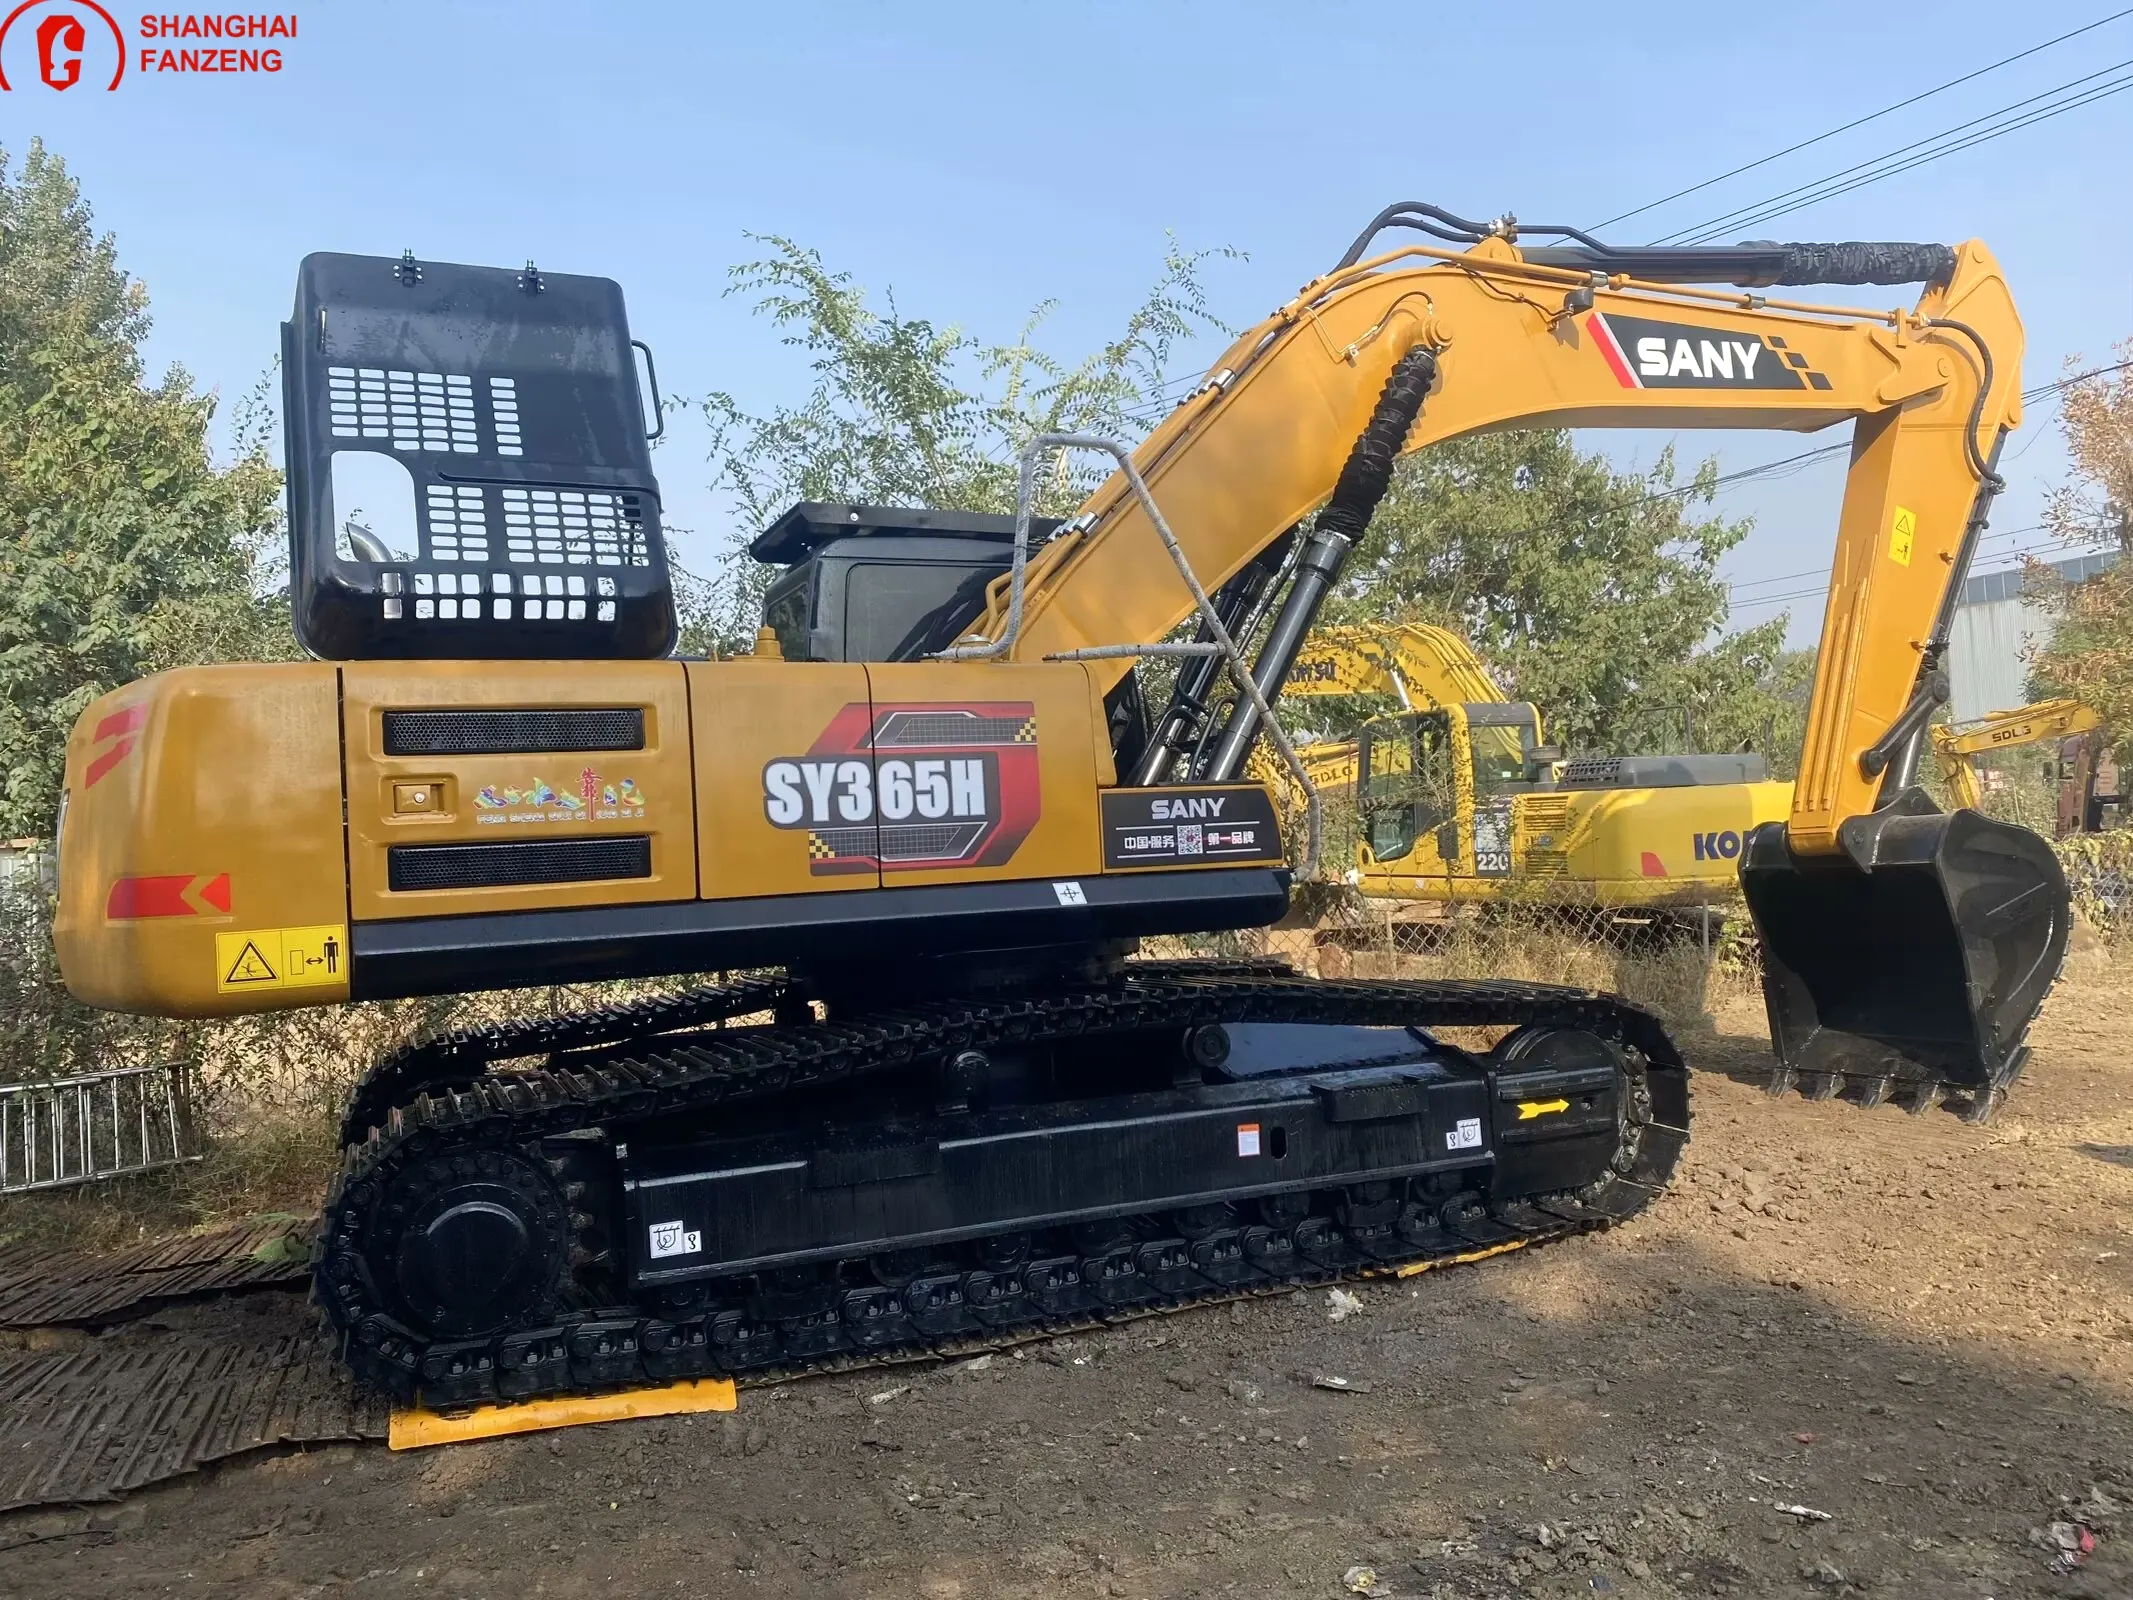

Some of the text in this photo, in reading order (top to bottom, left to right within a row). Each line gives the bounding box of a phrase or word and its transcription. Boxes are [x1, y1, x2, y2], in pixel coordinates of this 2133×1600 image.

[1637, 337, 1761, 380] SANY
[765, 759, 986, 825] SY365H
[1151, 797, 1226, 820] SANY
[1207, 831, 1255, 846] 第一品牌
[1477, 853, 1509, 871] 220
